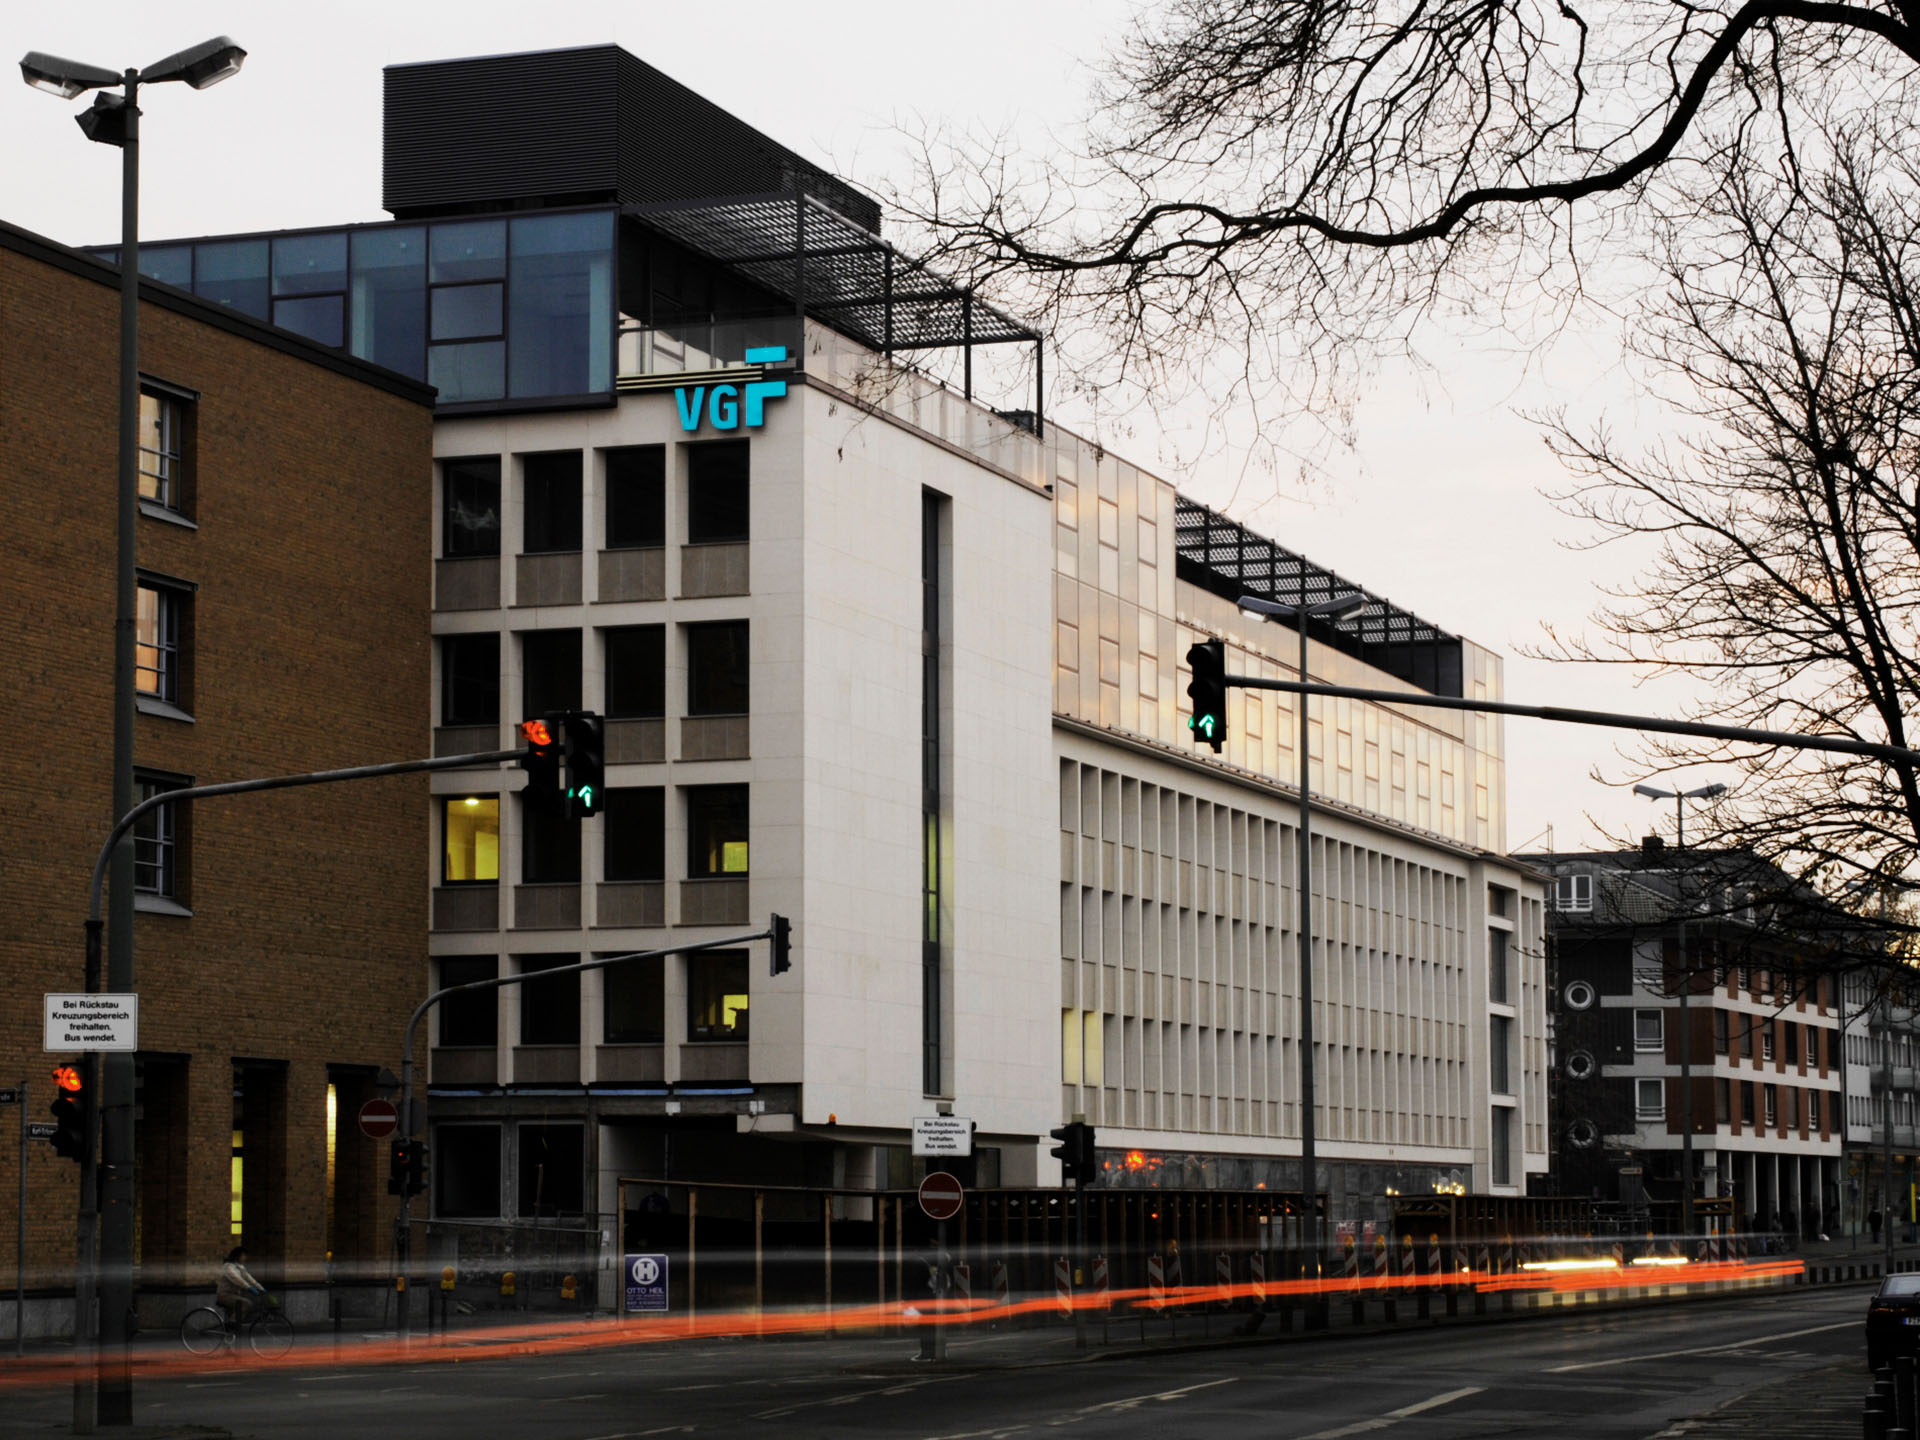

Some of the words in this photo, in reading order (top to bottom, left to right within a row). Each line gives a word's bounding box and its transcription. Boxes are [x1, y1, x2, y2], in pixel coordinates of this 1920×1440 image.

[674, 345, 787, 431] VGF
[62, 1000, 77, 1009] Bei
[79, 1000, 119, 1009] Rückstau
[52, 1011, 129, 1021] Kreuzungsbereich
[69, 1022, 112, 1031] freihalten.
[64, 1033, 80, 1042] Bus
[83, 1033, 116, 1042] wendet.
